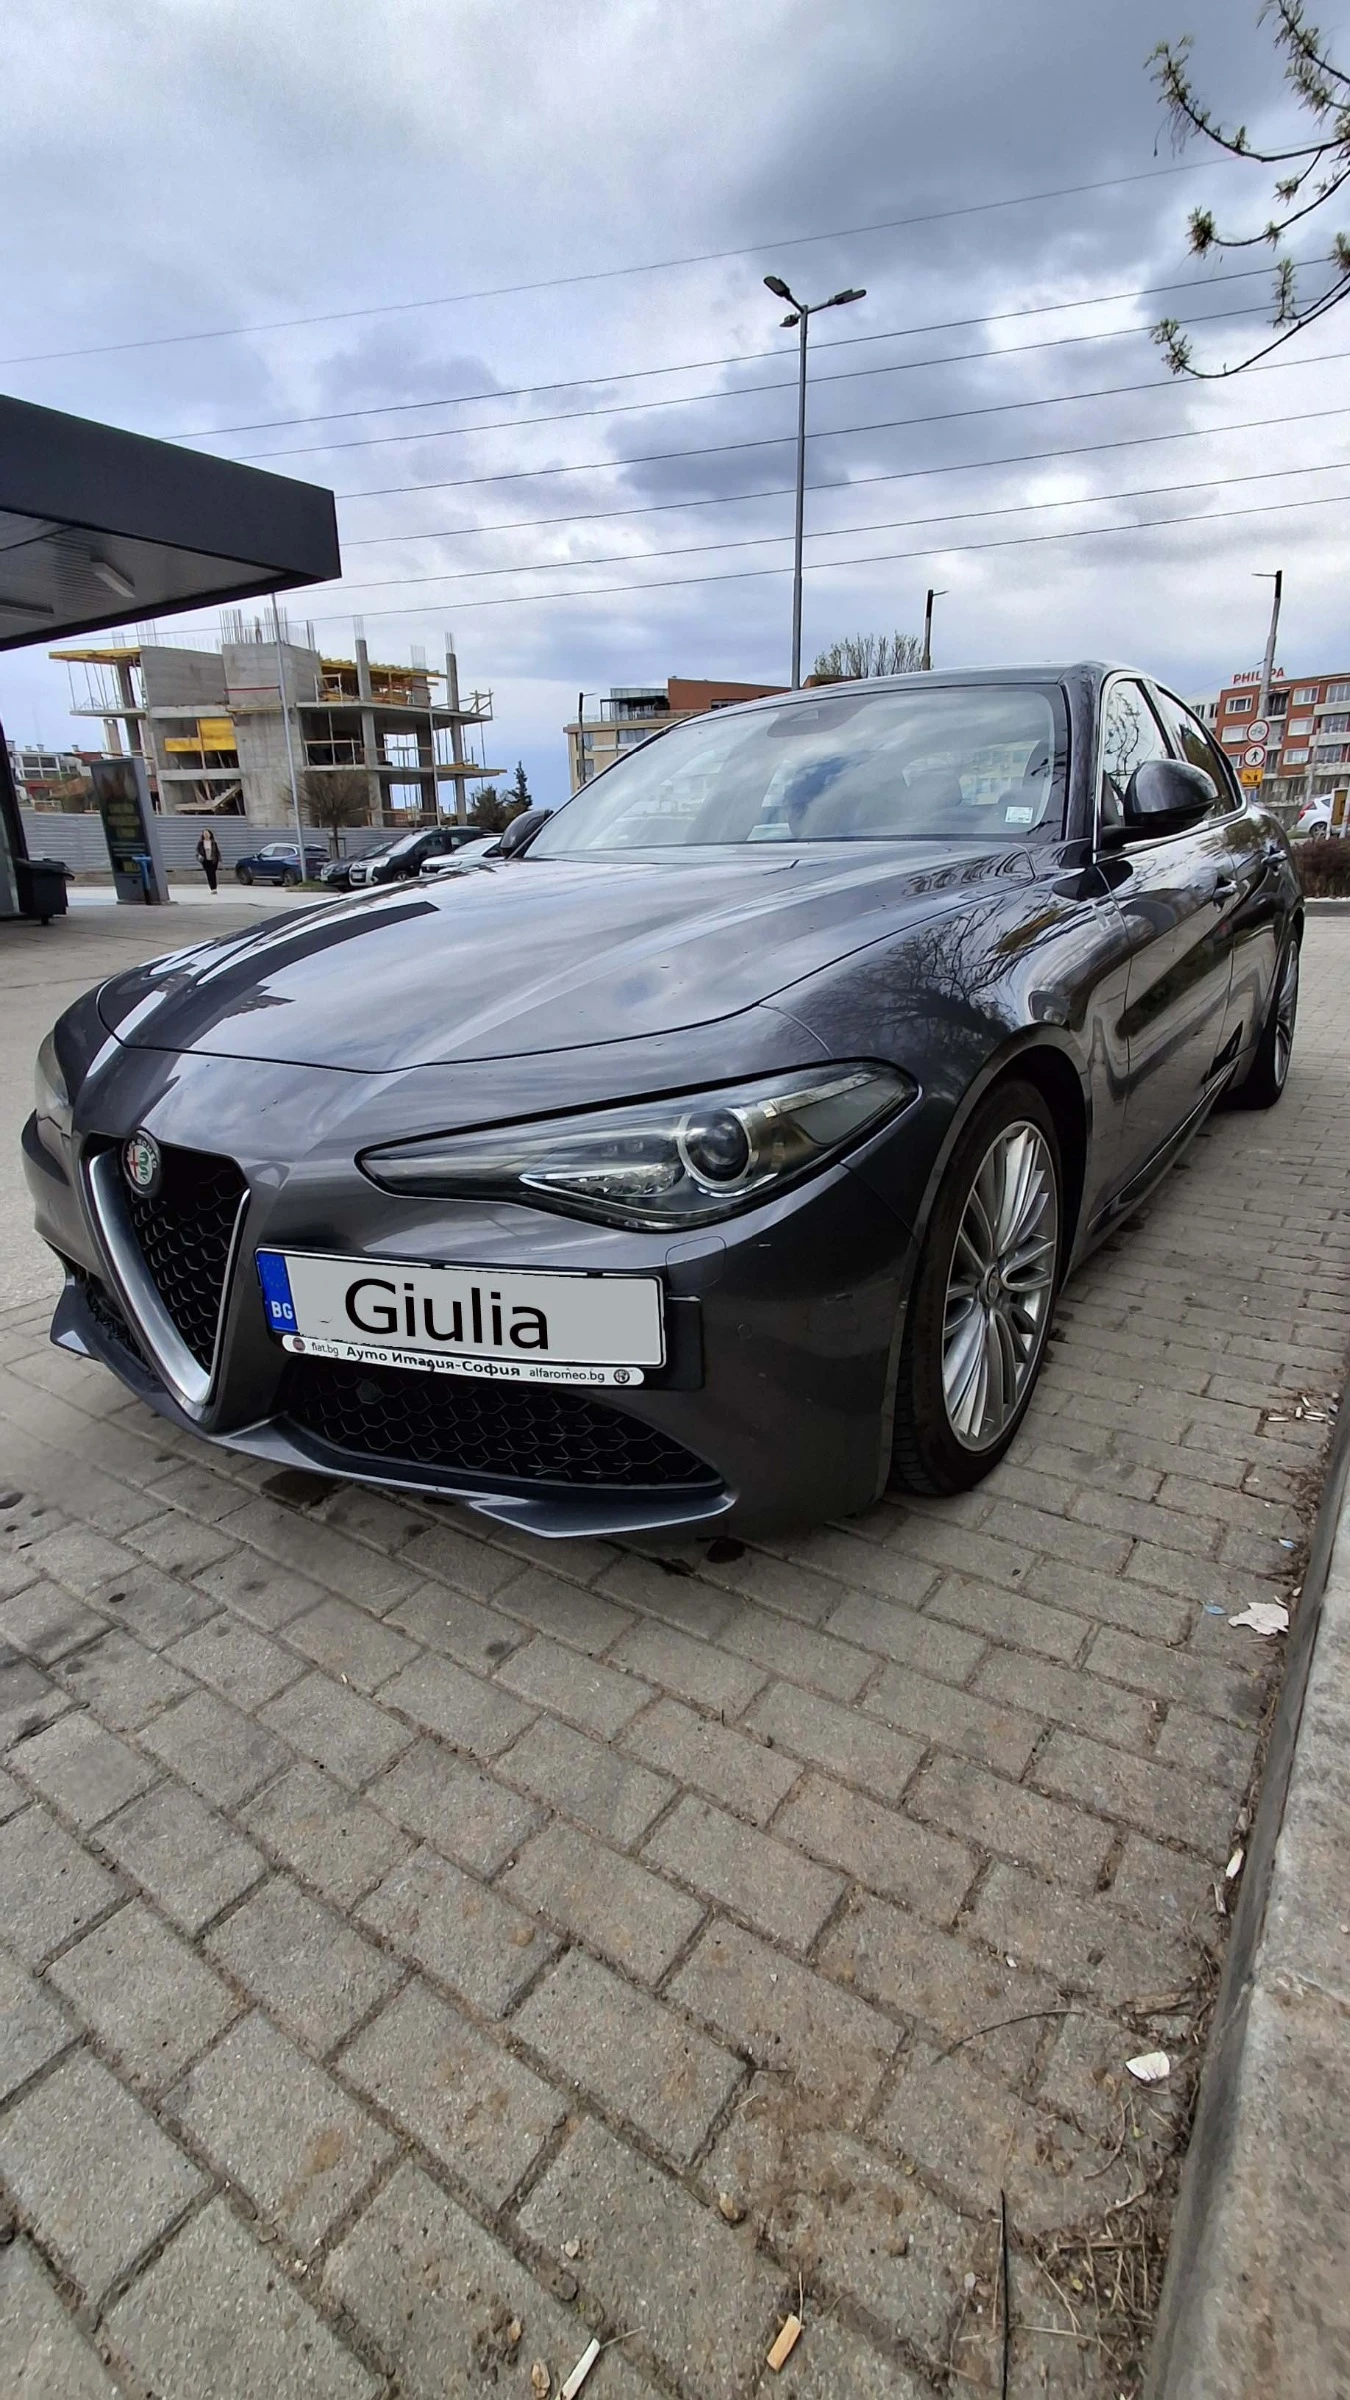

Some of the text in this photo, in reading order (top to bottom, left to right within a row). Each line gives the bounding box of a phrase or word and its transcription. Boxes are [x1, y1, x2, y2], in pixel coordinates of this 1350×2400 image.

[1232, 666, 1285, 685] PHILPA
[271, 1300, 294, 1320] BG
[311, 1341, 339, 1357] fiat.bg
[529, 1367, 605, 1383] alfaromeo.bg
